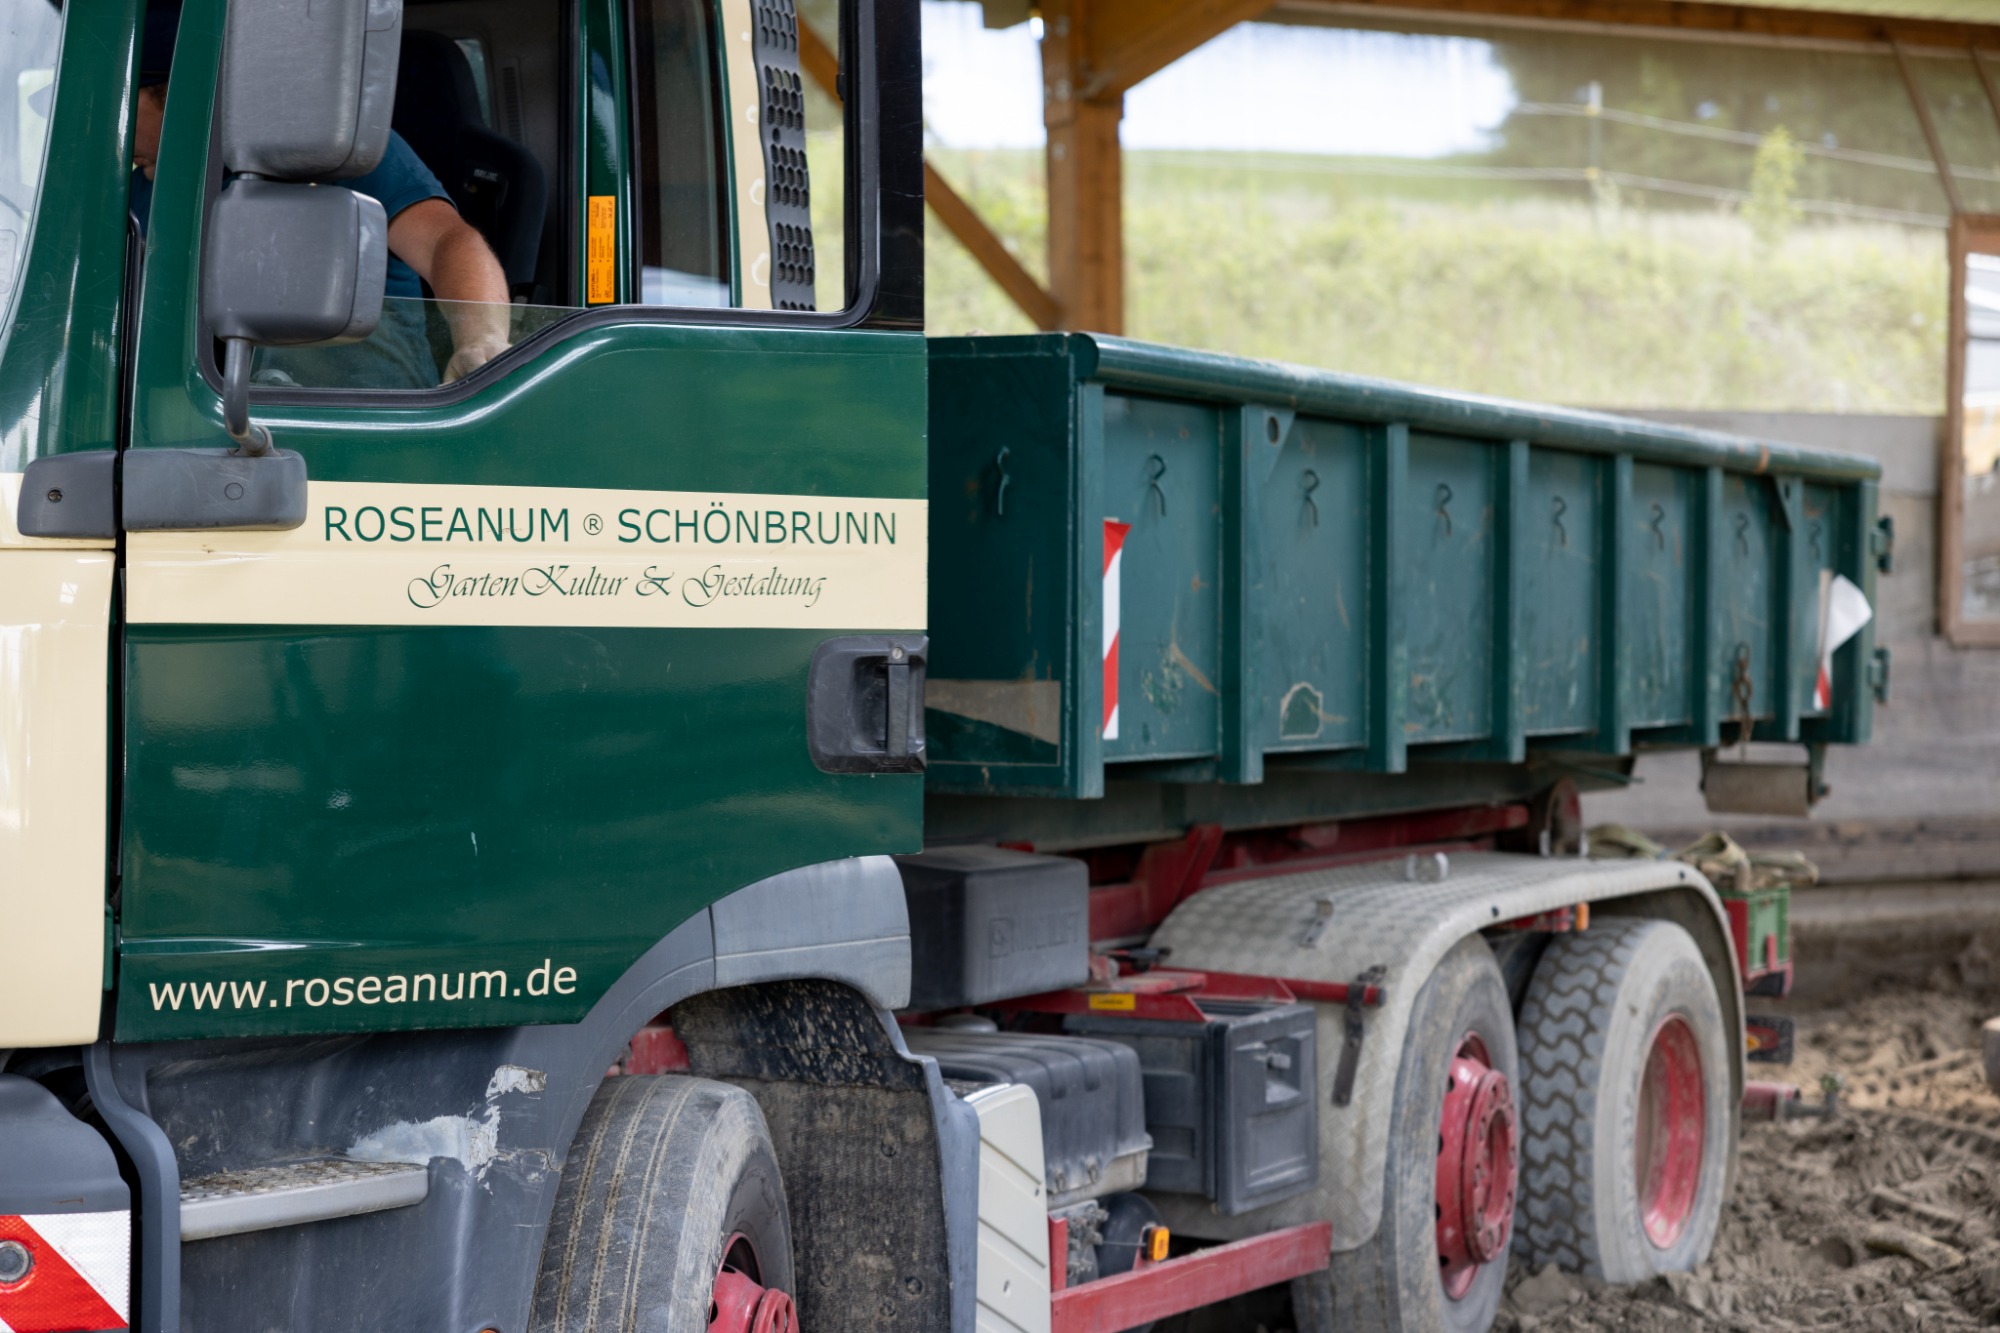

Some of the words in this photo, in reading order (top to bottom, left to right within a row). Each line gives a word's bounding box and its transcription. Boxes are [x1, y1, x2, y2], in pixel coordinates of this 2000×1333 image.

[324, 505, 569, 542] ROSEANUM
[582, 512, 603, 535] ®
[617, 501, 896, 544] SCHÖNBRUNN
[635, 565, 674, 596] &
[682, 564, 827, 607] Gestaltung
[149, 957, 577, 1011] www.roseanum.de
